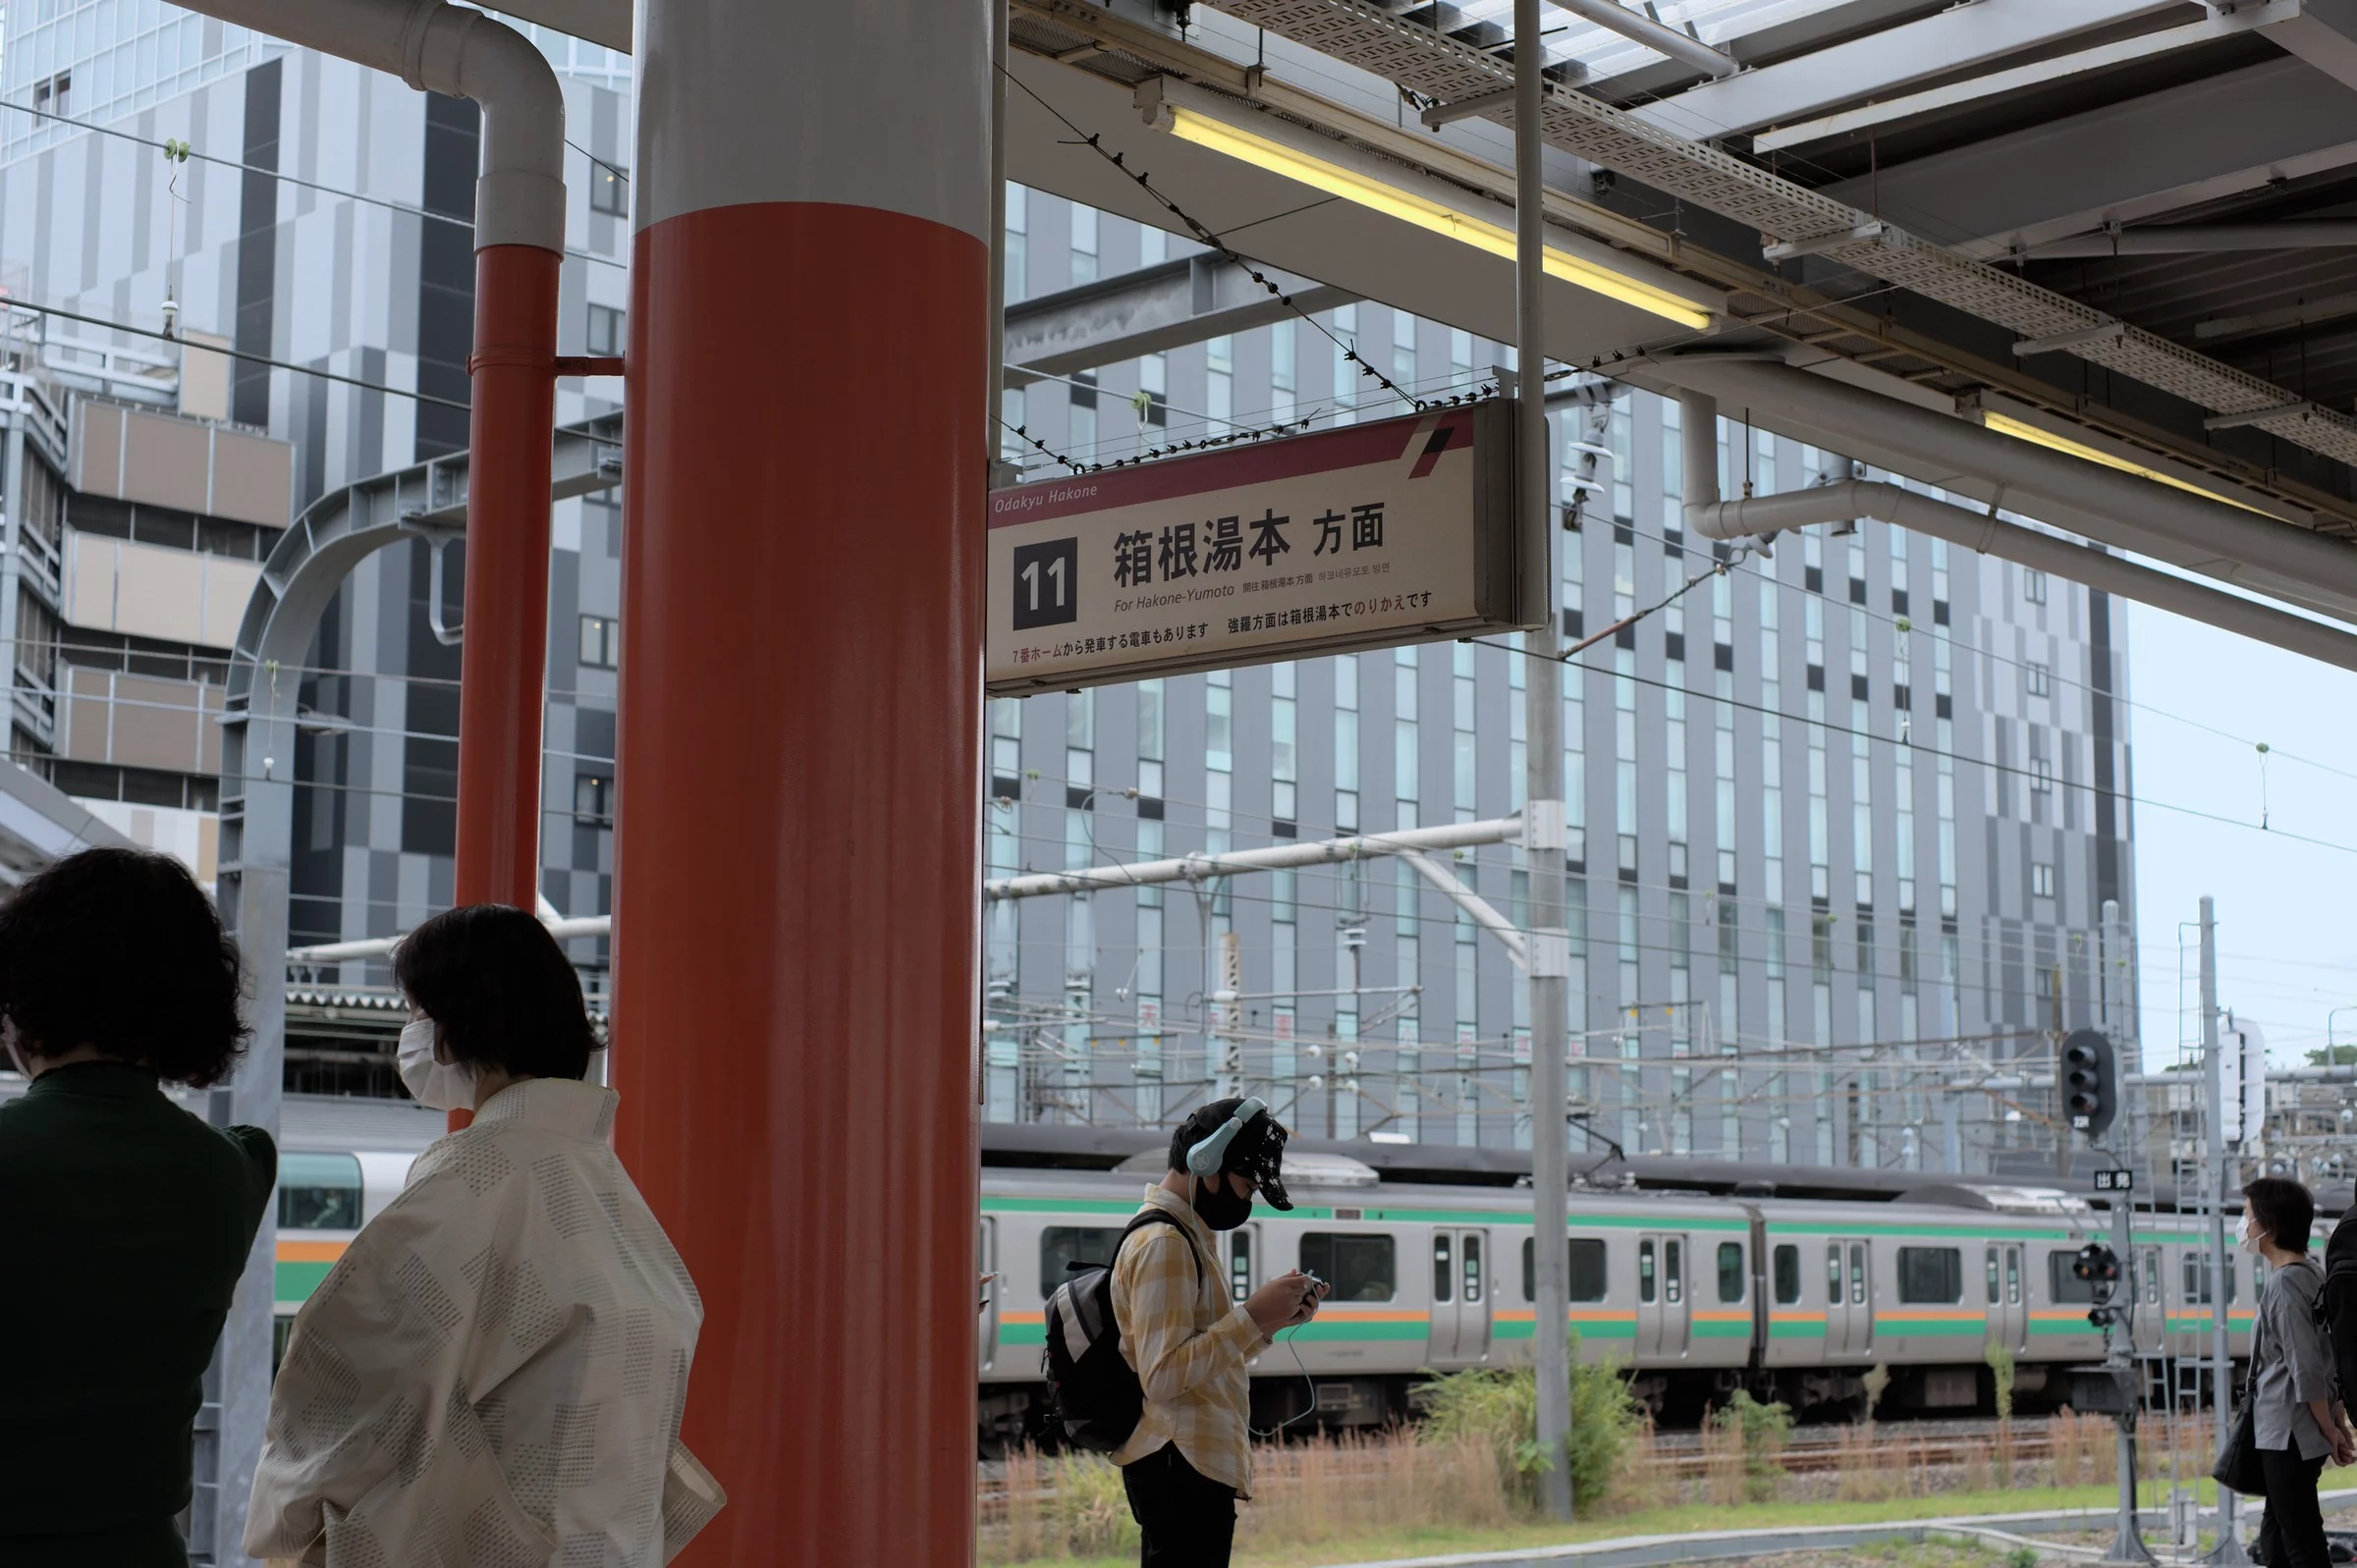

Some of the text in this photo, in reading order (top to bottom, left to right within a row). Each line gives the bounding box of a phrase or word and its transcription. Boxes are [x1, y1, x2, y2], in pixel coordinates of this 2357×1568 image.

[995, 486, 1098, 514] Odakyu Hakone
[1113, 502, 1386, 588] 箱根湯本 方面
[1021, 557, 1066, 612] 11
[1114, 584, 1234, 613] For Hakone-Yumoto
[1013, 590, 1433, 664] 7番ホームから発車する電車もあります 強羅方面は箱根湯本でのりかえです
